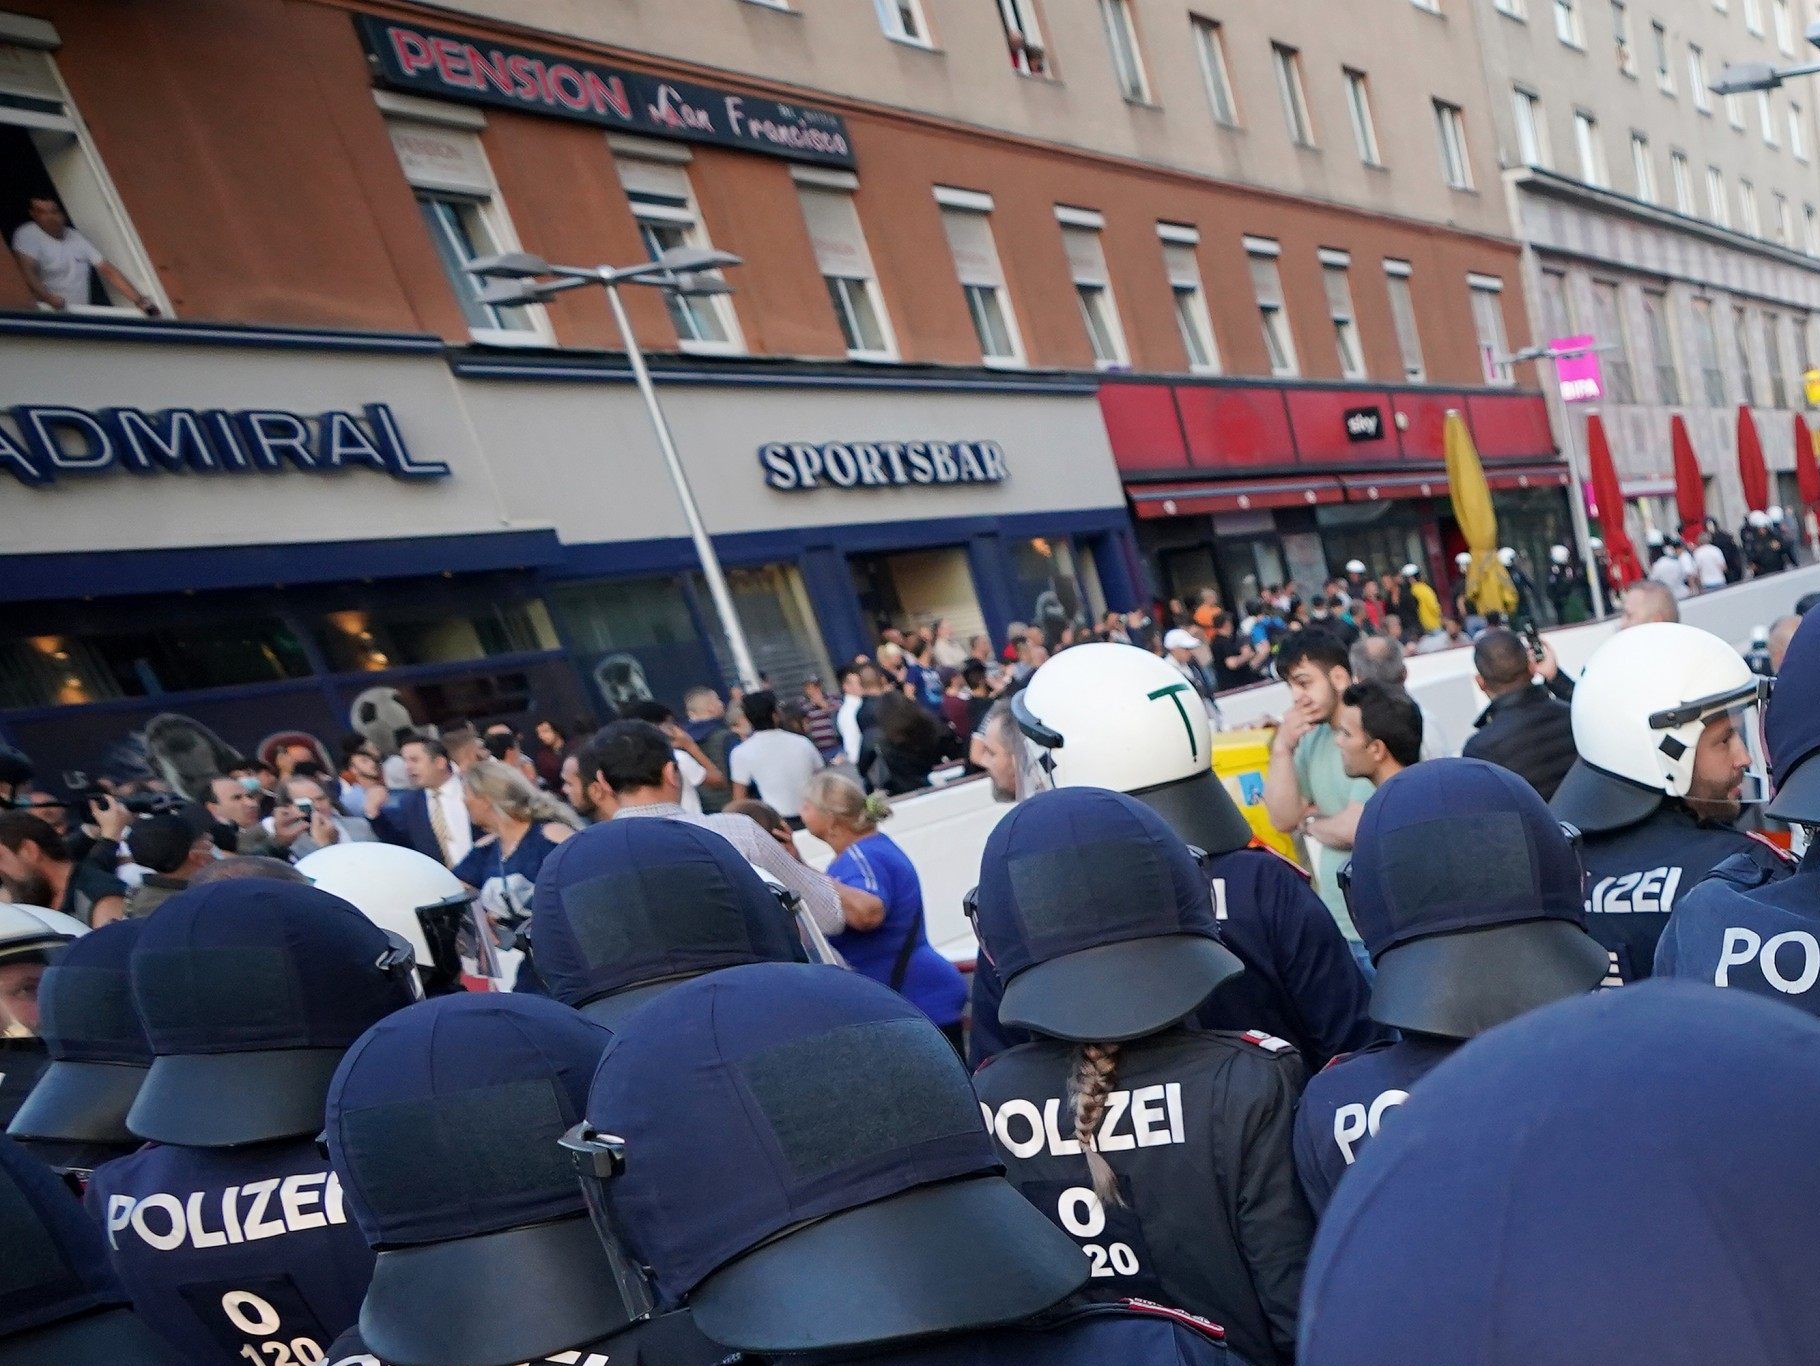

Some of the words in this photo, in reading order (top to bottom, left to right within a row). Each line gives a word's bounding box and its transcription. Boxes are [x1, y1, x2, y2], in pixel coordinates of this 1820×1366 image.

[388, 27, 633, 120] PENSION
[761, 440, 1009, 490] SPORTSBAR
[1147, 683, 1197, 758] T
[1584, 867, 1682, 913] IZEI
[979, 1082, 1185, 1159] OLZEI
[107, 1171, 347, 1250] POLIZEI
